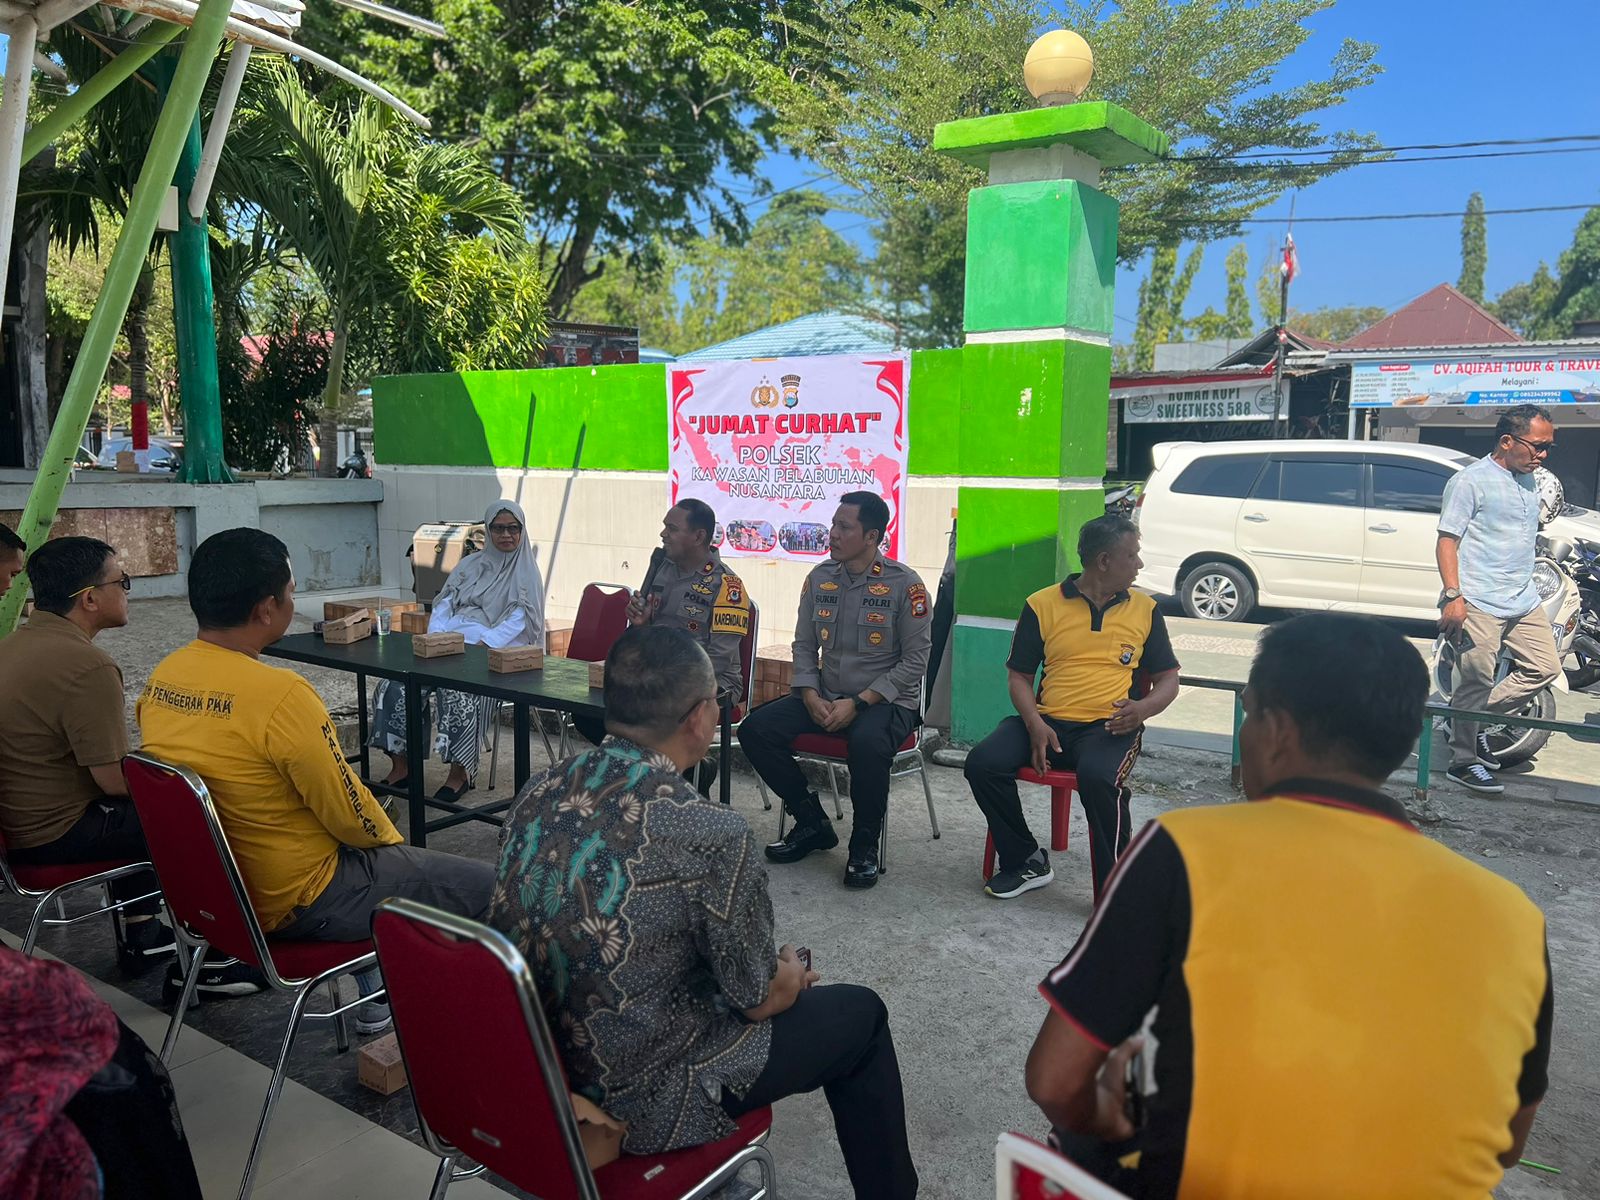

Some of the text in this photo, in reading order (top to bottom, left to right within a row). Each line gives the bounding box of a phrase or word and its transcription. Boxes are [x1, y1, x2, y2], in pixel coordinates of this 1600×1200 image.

[1433, 362, 1453, 375] CV.
[1456, 362, 1502, 375] AQIFAH
[1505, 361, 1542, 373] TOUR
[1545, 360, 1555, 372] &
[1157, 403, 1224, 419] SWEETNESS
[1227, 401, 1251, 417] 588
[688, 412, 882, 435] "JUMAT CURHAT"
[738, 445, 822, 466] POLSEK
[691, 467, 876, 485] KAWASAN PELABUHAN
[728, 483, 826, 500] NUSANTARA
[815, 594, 839, 604] SUKRI
[862, 597, 891, 608] POLRI
[152, 686, 204, 711] PENGGERAK
[206, 697, 233, 714] PKK
